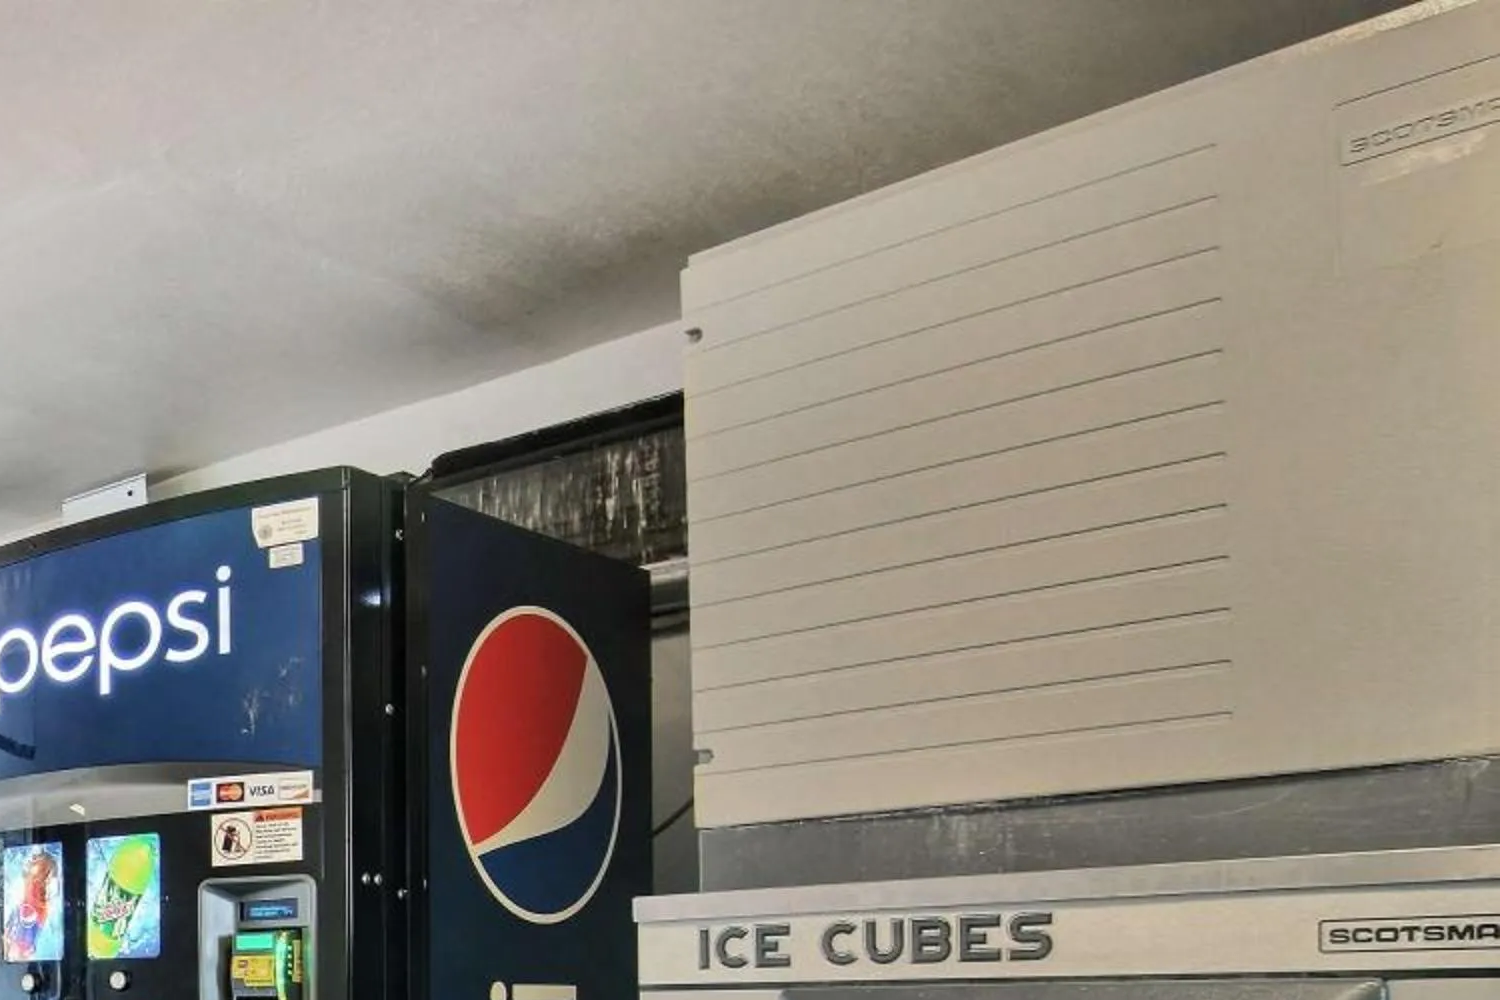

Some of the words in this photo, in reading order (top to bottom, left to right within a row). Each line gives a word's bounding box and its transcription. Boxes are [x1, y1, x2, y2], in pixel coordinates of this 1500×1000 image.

[249, 784, 275, 797] VISA
[699, 923, 792, 970] ICE
[821, 912, 1054, 966] CUBES
[1329, 923, 1500, 944] SCOTSMA
